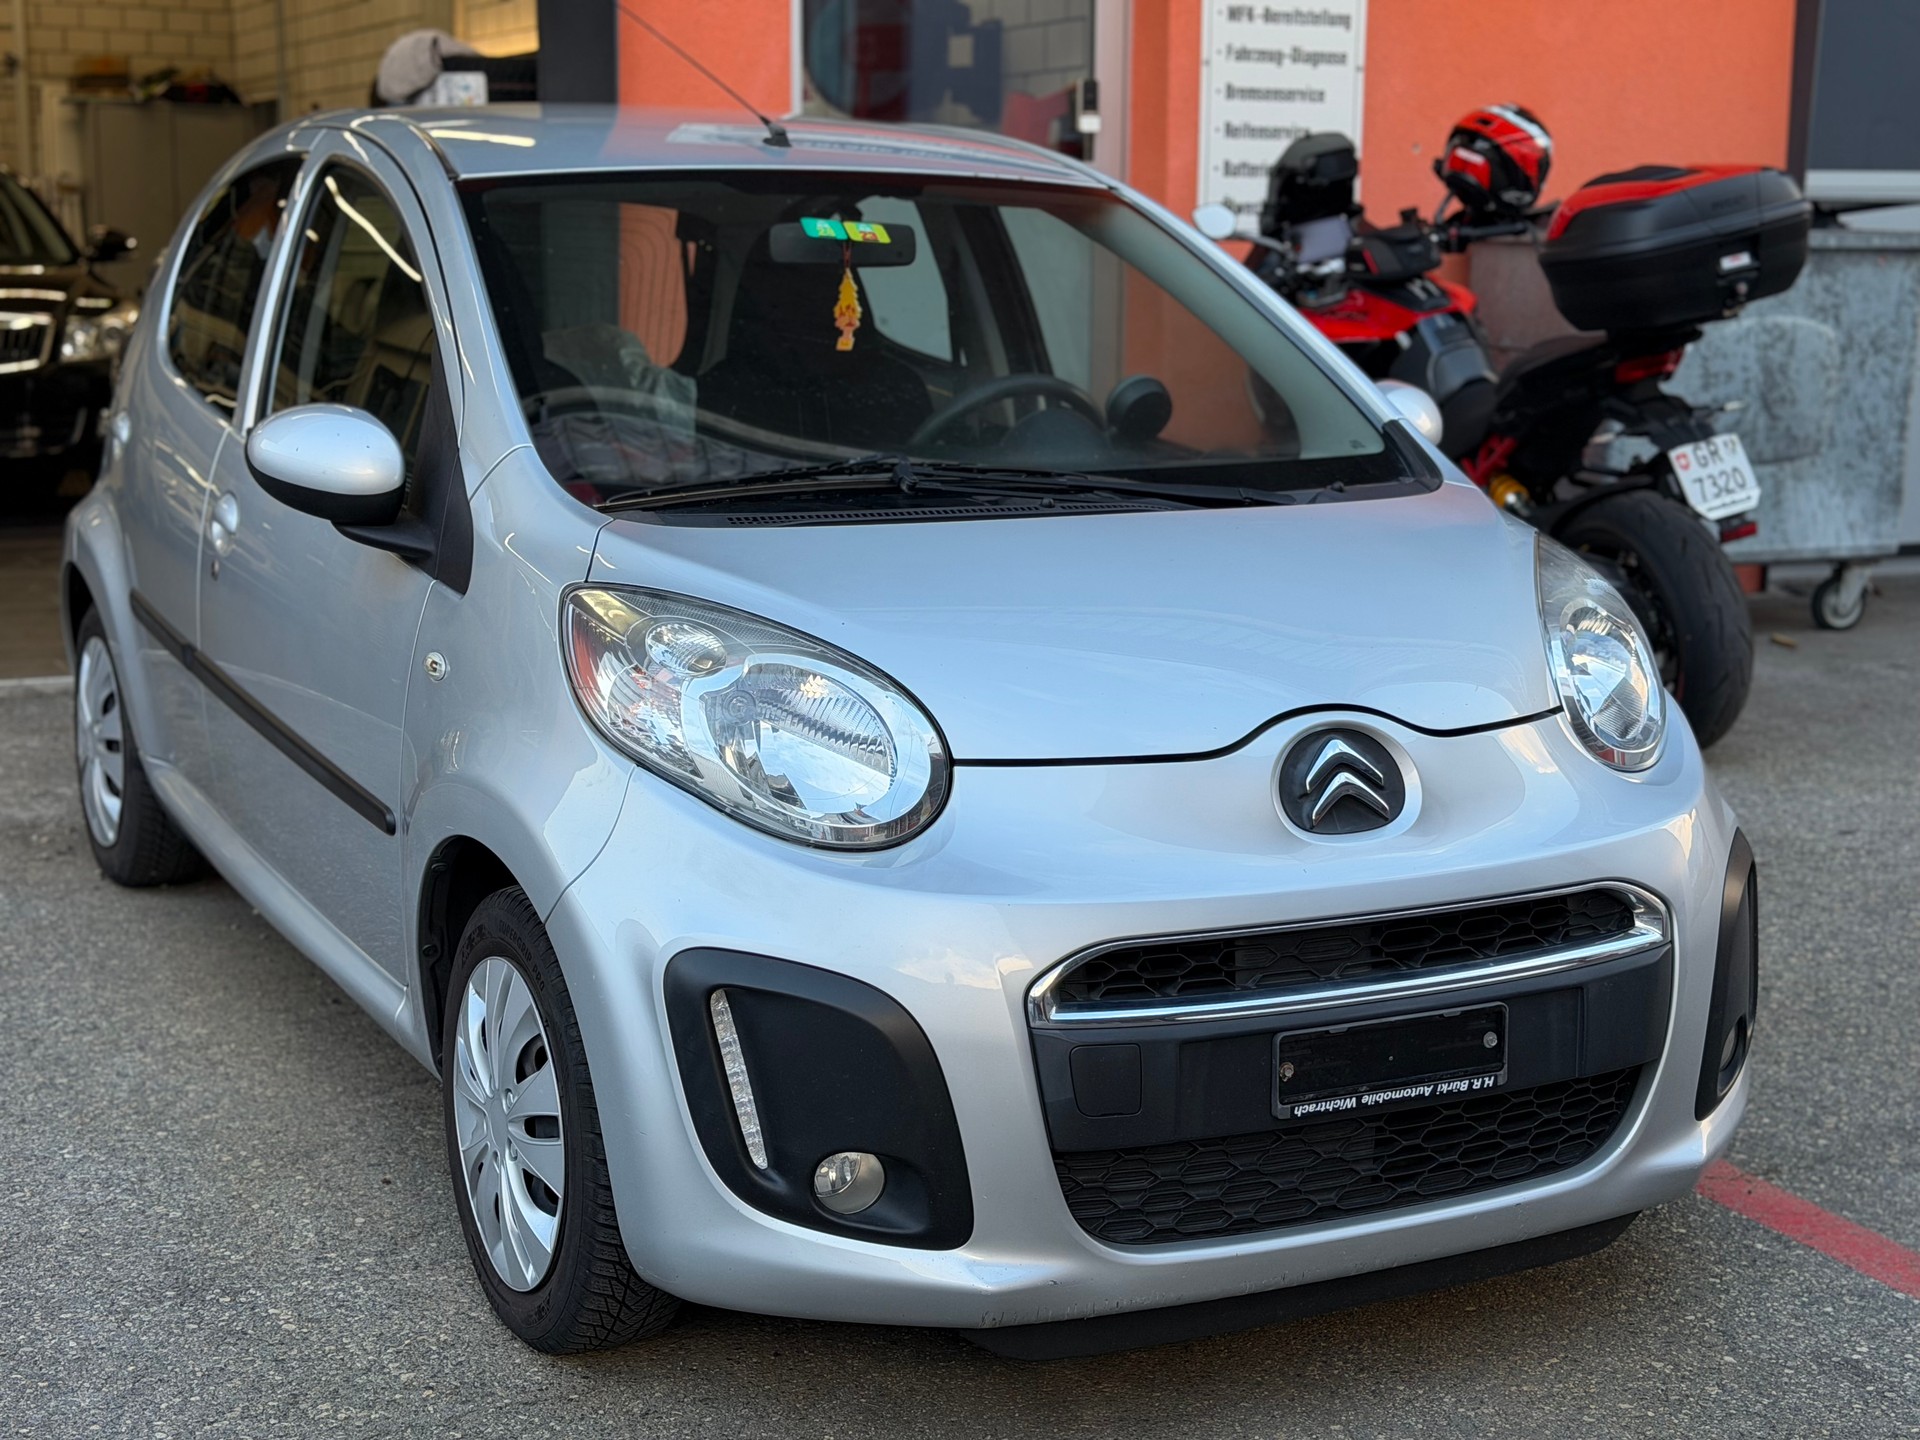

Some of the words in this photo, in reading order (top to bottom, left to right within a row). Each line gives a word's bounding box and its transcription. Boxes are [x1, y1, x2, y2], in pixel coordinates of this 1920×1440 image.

[1692, 439, 1724, 468] GR
[1692, 466, 1747, 503] 7320
[1361, 1084, 1434, 1106] Automobile
[1436, 1079, 1470, 1095] Bürki
[1294, 1096, 1357, 1118] Wichtrach
